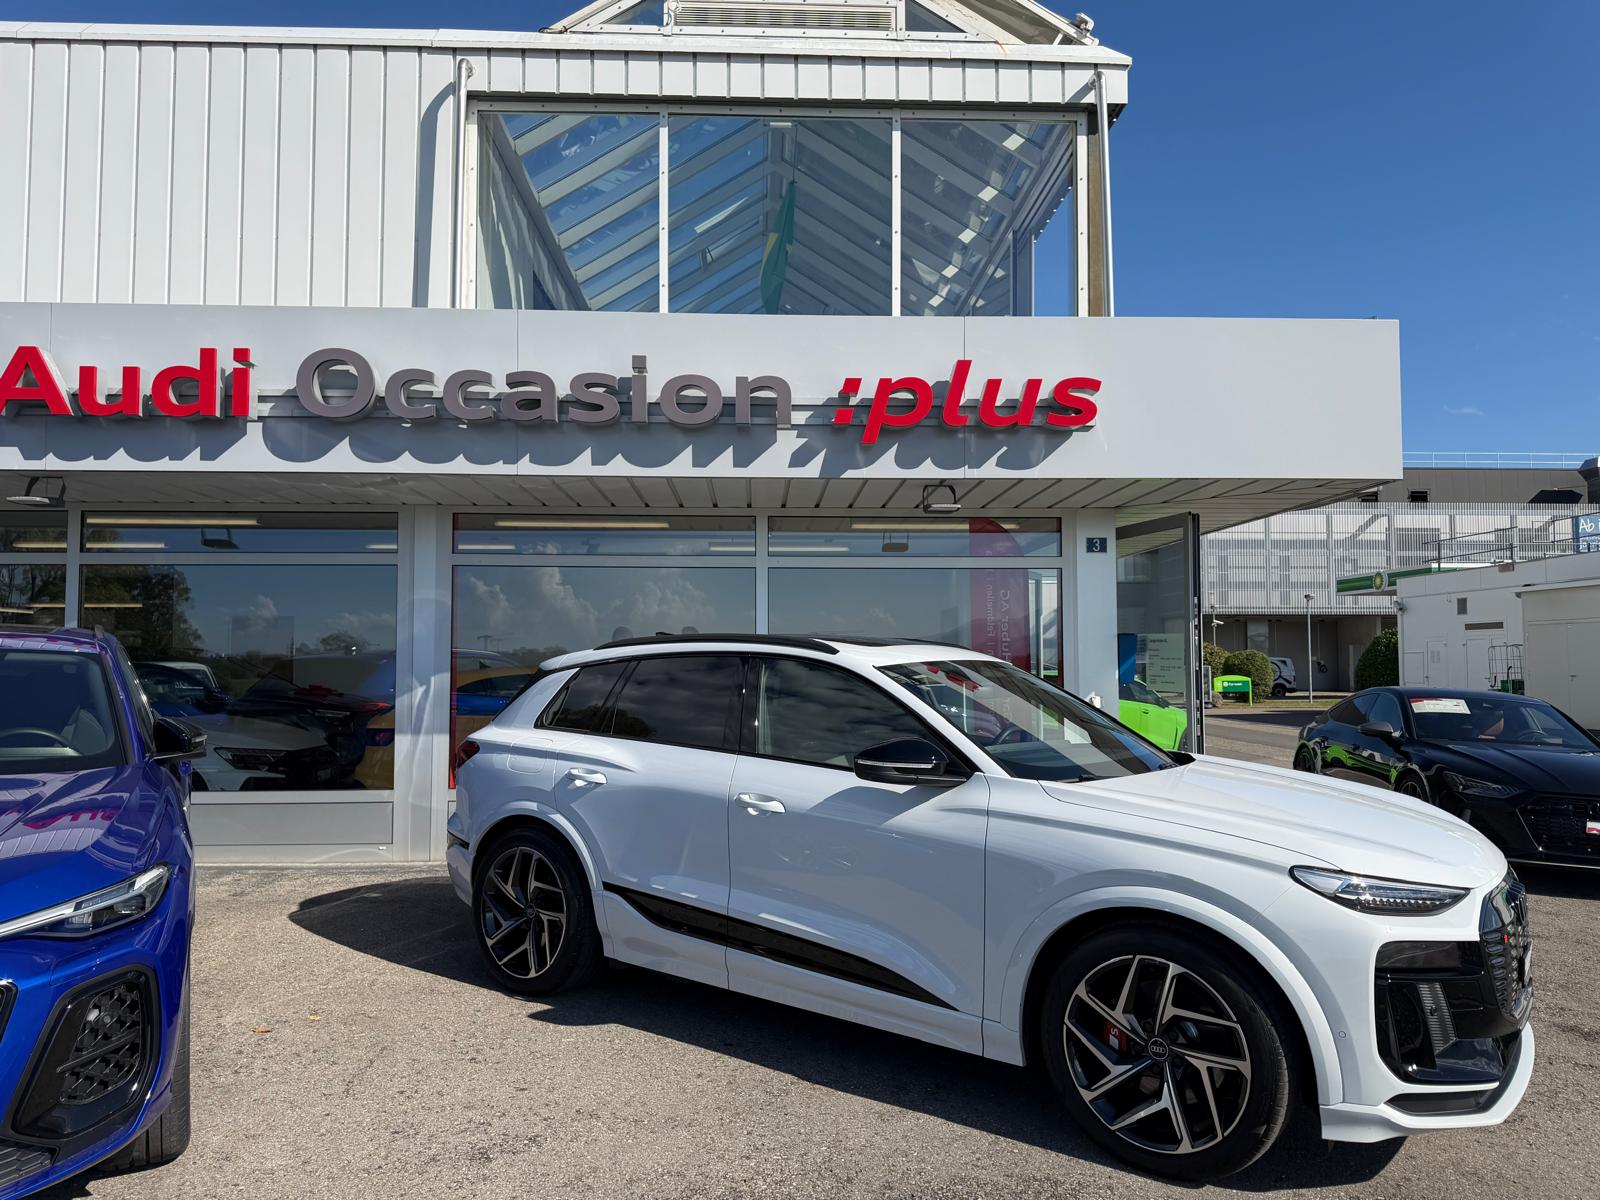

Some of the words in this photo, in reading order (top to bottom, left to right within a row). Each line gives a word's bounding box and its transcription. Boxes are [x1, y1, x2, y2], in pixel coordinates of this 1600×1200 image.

[0, 345, 252, 418] Audi
[296, 347, 794, 428] Occasion
[1092, 538, 1100, 552] 3
